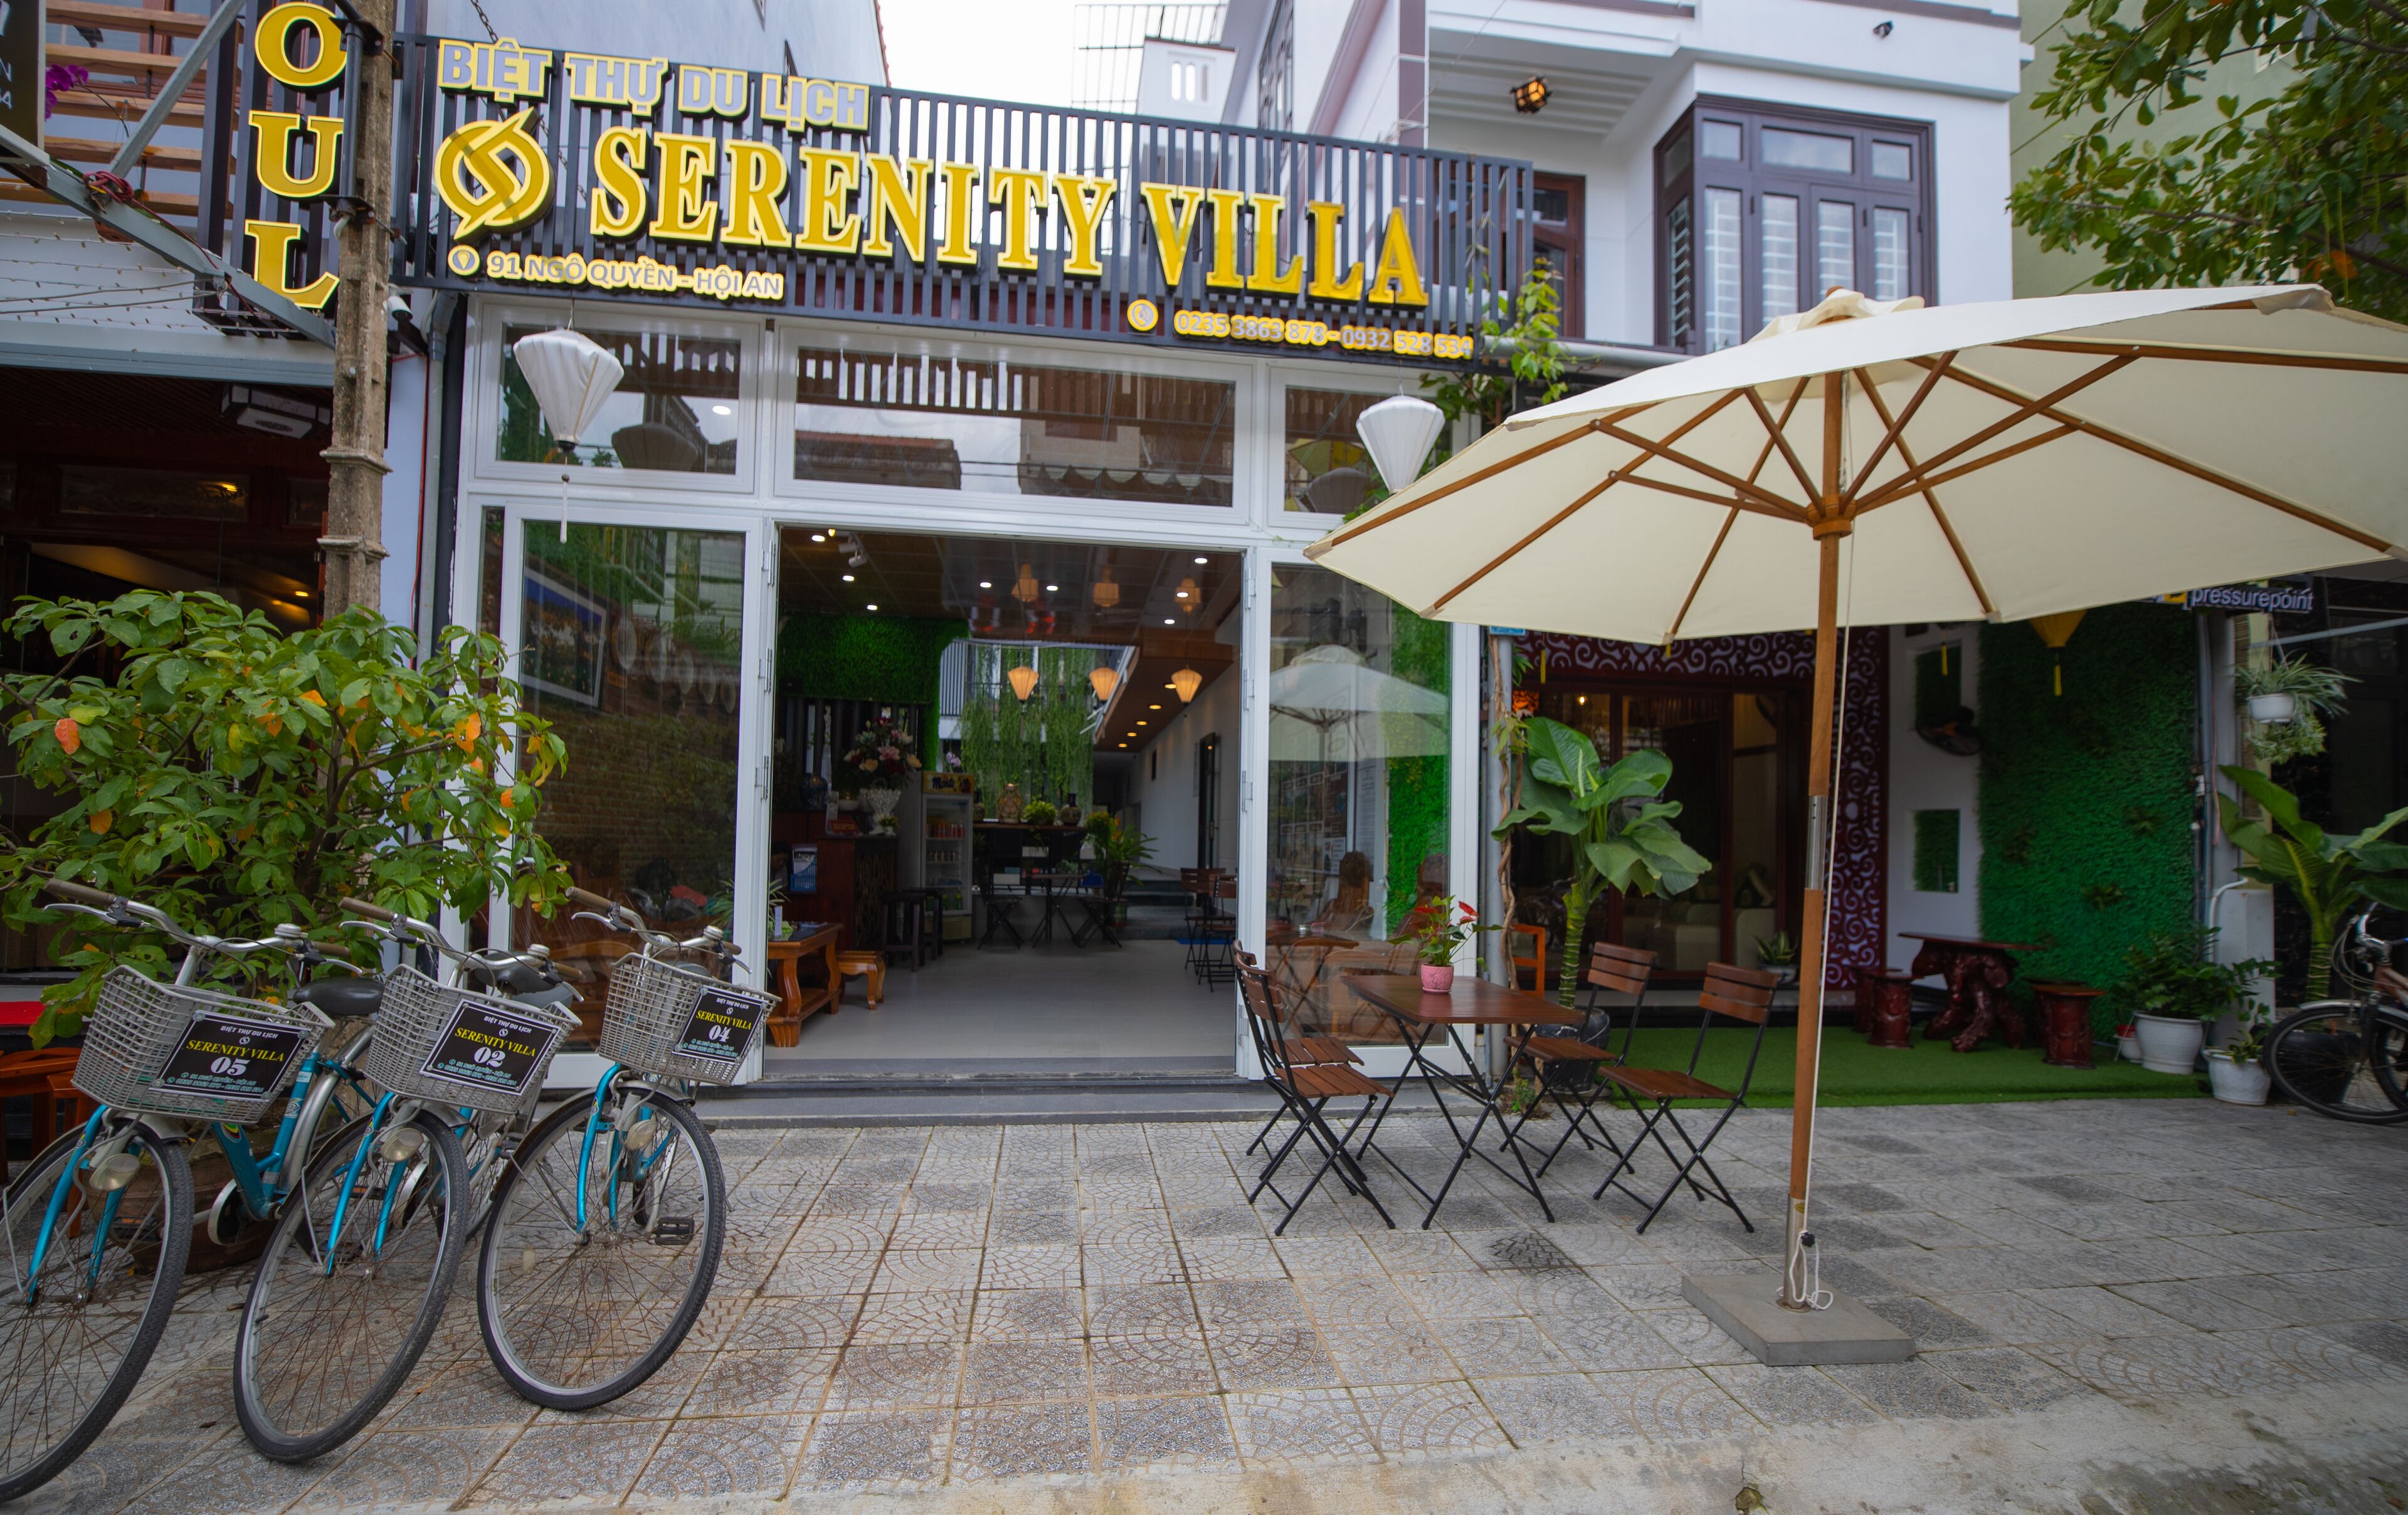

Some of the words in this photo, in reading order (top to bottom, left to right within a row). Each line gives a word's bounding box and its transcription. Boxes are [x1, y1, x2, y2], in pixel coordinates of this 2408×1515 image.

[440, 38, 552, 102] BIỆT
[566, 53, 668, 115] THỰ
[679, 65, 747, 117] DU
[762, 73, 869, 132] LỊCH
[591, 127, 1117, 277] SERENITY
[1140, 182, 1430, 306] VILLA
[488, 254, 520, 277] 91
[527, 254, 585, 281] NGÔ
[589, 256, 675, 288] QUYỀN
[695, 266, 742, 297] HỘI
[744, 273, 782, 298] AN
[1176, 312, 1228, 336] 0235
[1232, 316, 1284, 340] 3863
[1287, 321, 1326, 344] 878
[1341, 327, 1391, 349] 0932
[1394, 331, 1433, 354] 528
[1435, 334, 1472, 357] 534
[2191, 588, 2315, 613] pressurepoint
[483, 1015, 498, 1024] BIỆT
[696, 1010, 732, 1025] SERENITY
[732, 1018, 752, 1030] VILLA
[455, 1027, 508, 1048] SERENITY
[508, 1040, 536, 1057] VILLA
[709, 1025, 731, 1043] 04
[186, 1039, 250, 1057] SERENITY
[250, 1048, 284, 1062] VILLA
[474, 1047, 506, 1068] 02
[211, 1056, 250, 1076] 05
